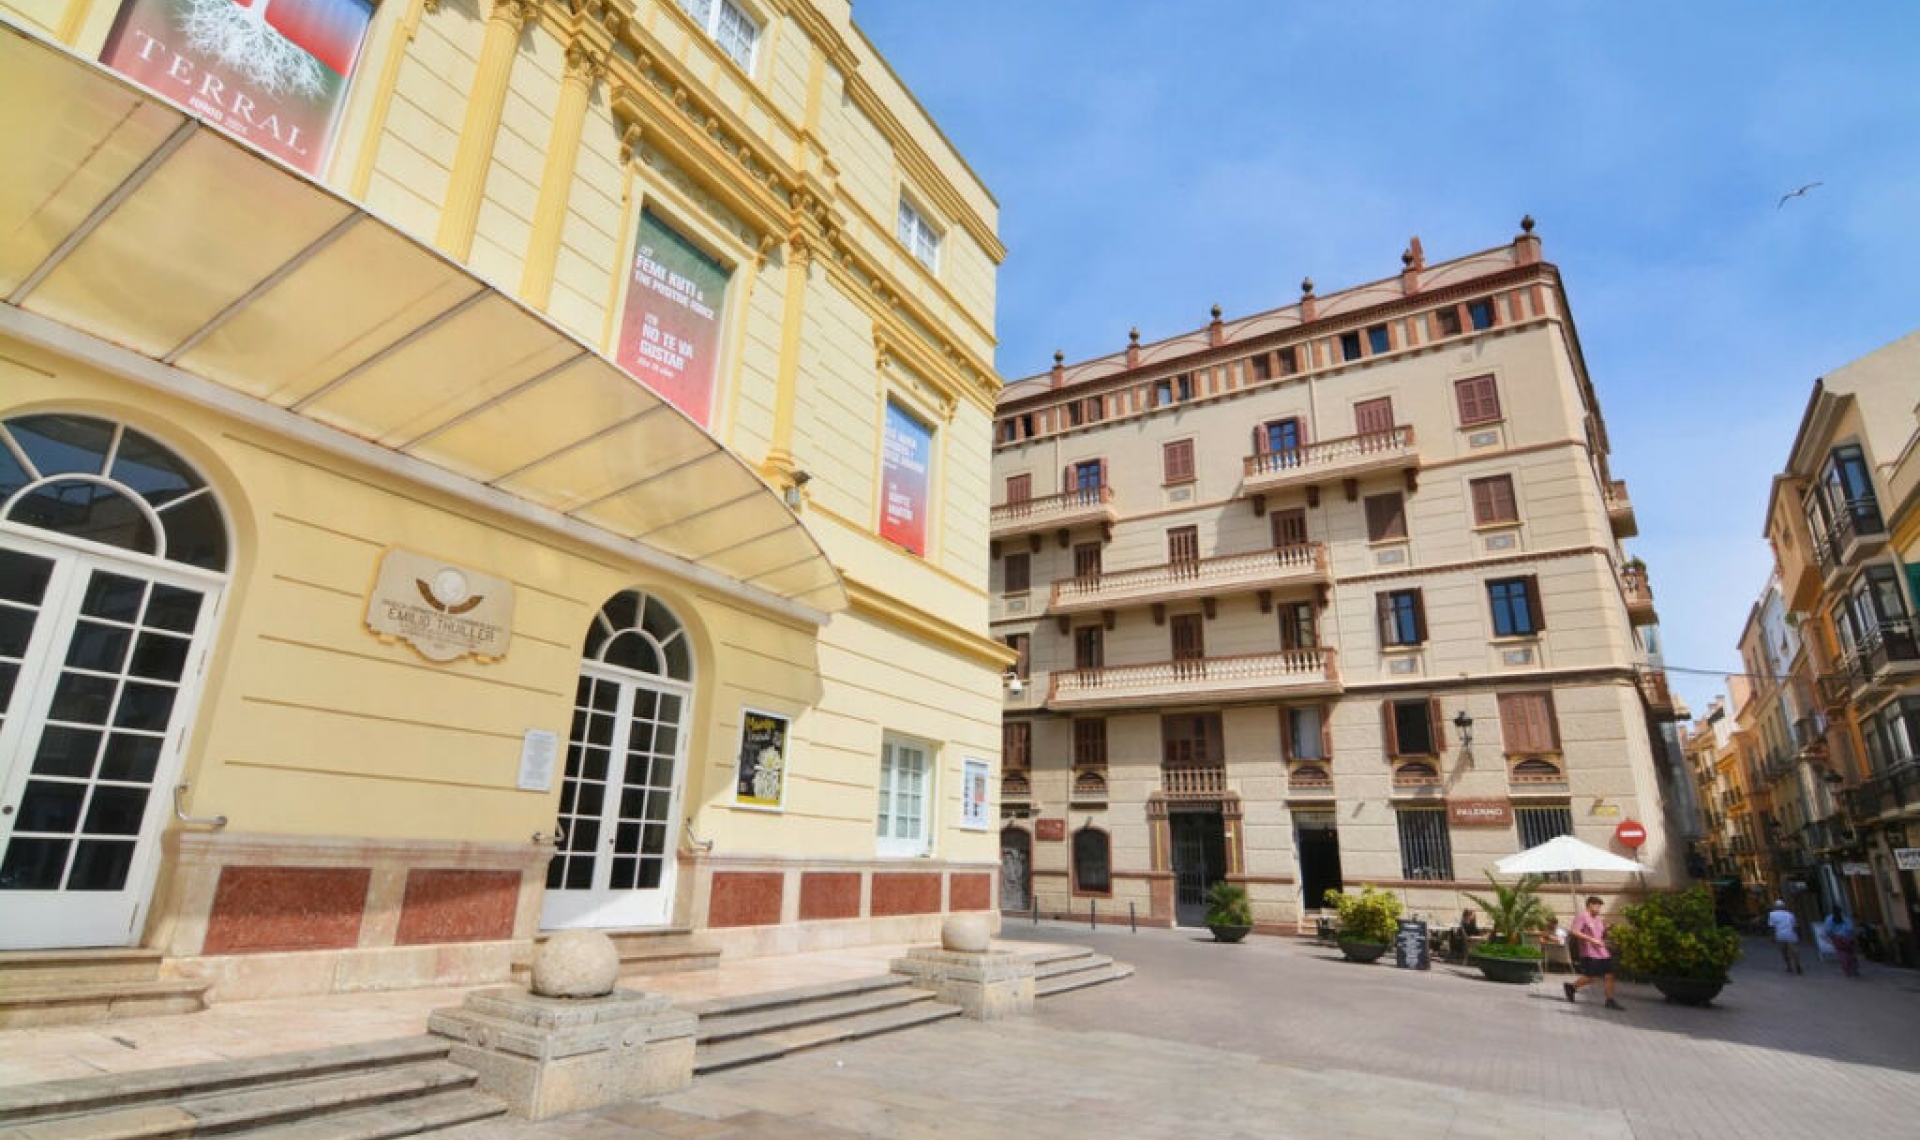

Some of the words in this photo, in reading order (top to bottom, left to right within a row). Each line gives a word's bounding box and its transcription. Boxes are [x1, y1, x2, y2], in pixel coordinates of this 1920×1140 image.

[135, 29, 307, 155] TERRAL
[636, 253, 666, 282] FEMI
[668, 266, 697, 297] KUTI
[640, 339, 685, 372] GUSTAR
[642, 323, 660, 342] NO
[662, 331, 677, 351] TE
[678, 339, 694, 359] VA
[387, 606, 431, 630] EMILIO
[1456, 807, 1503, 817] PALERMO
